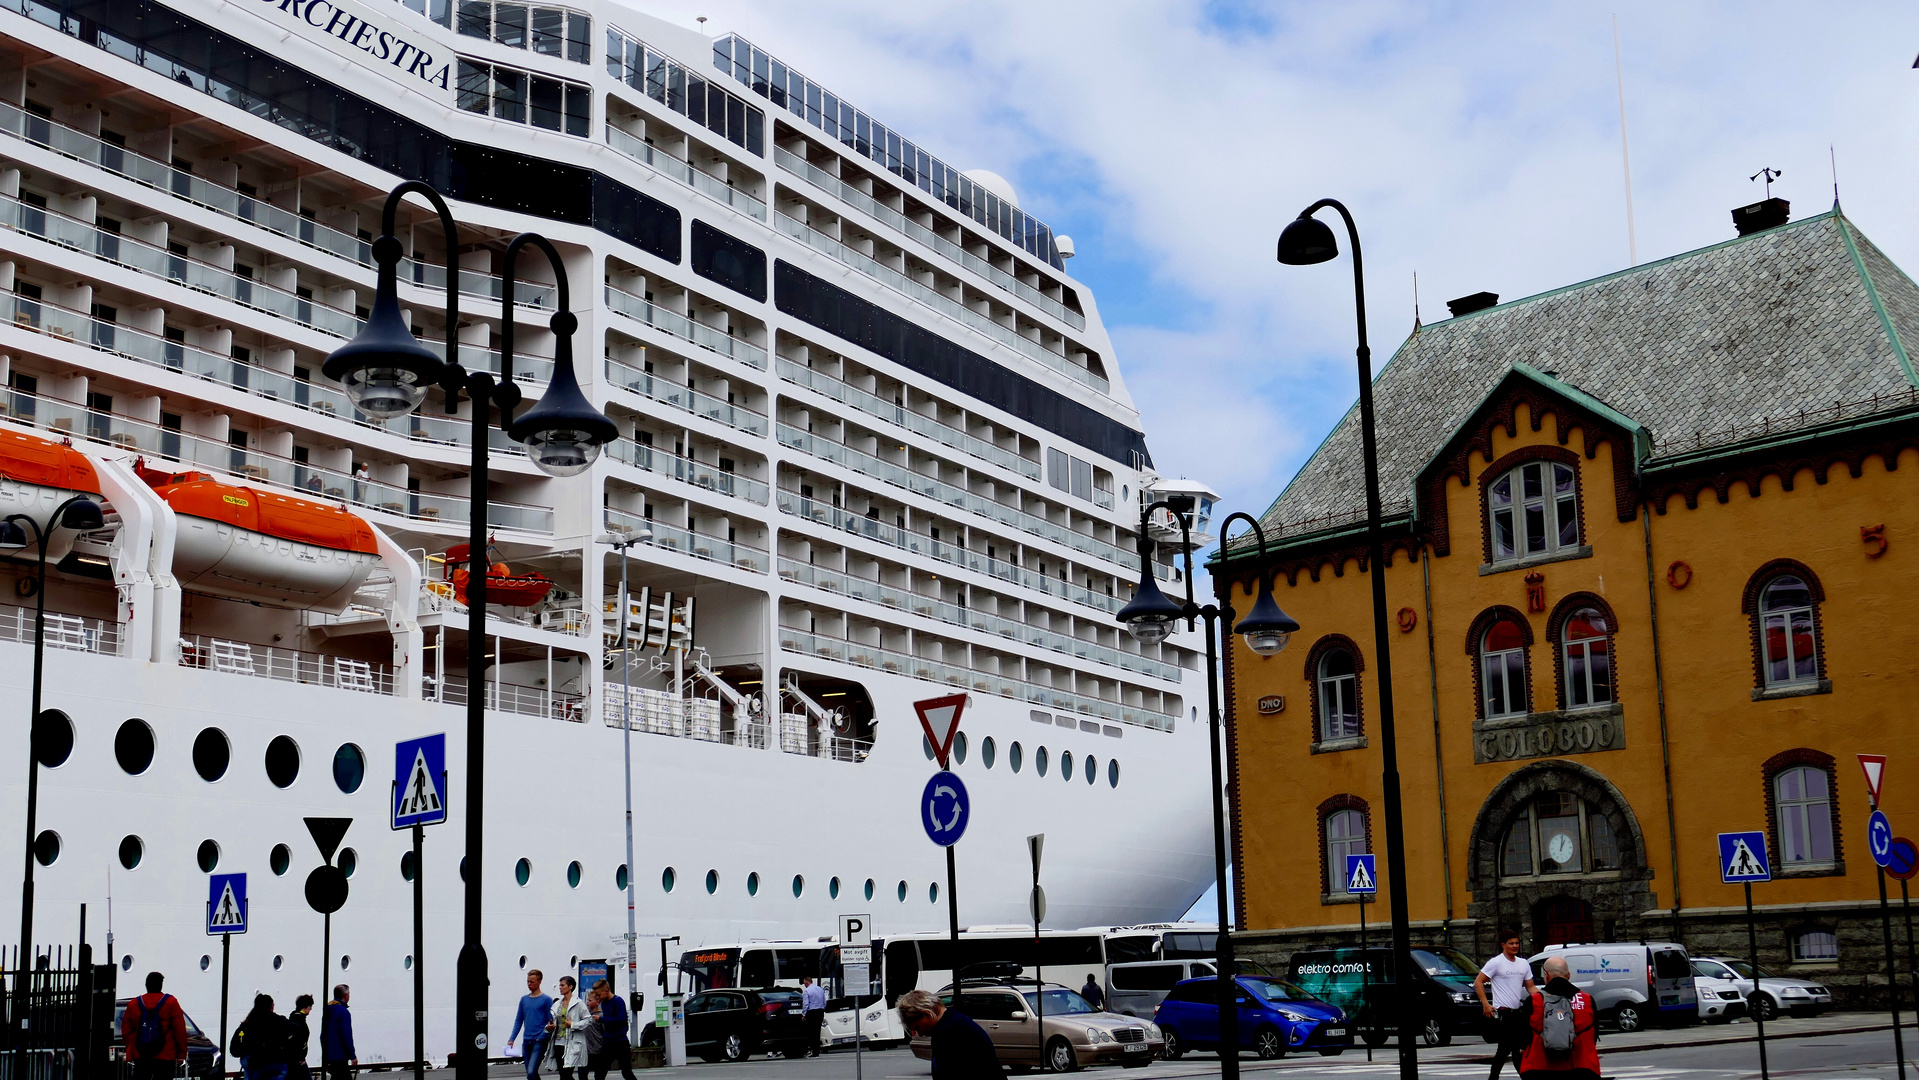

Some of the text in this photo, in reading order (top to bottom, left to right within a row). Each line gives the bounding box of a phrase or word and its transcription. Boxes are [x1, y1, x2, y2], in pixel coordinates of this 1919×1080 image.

[262, 0, 451, 91] RCHESTRA
[847, 919, 862, 942] P
[1298, 962, 1371, 974] elektro comfot
